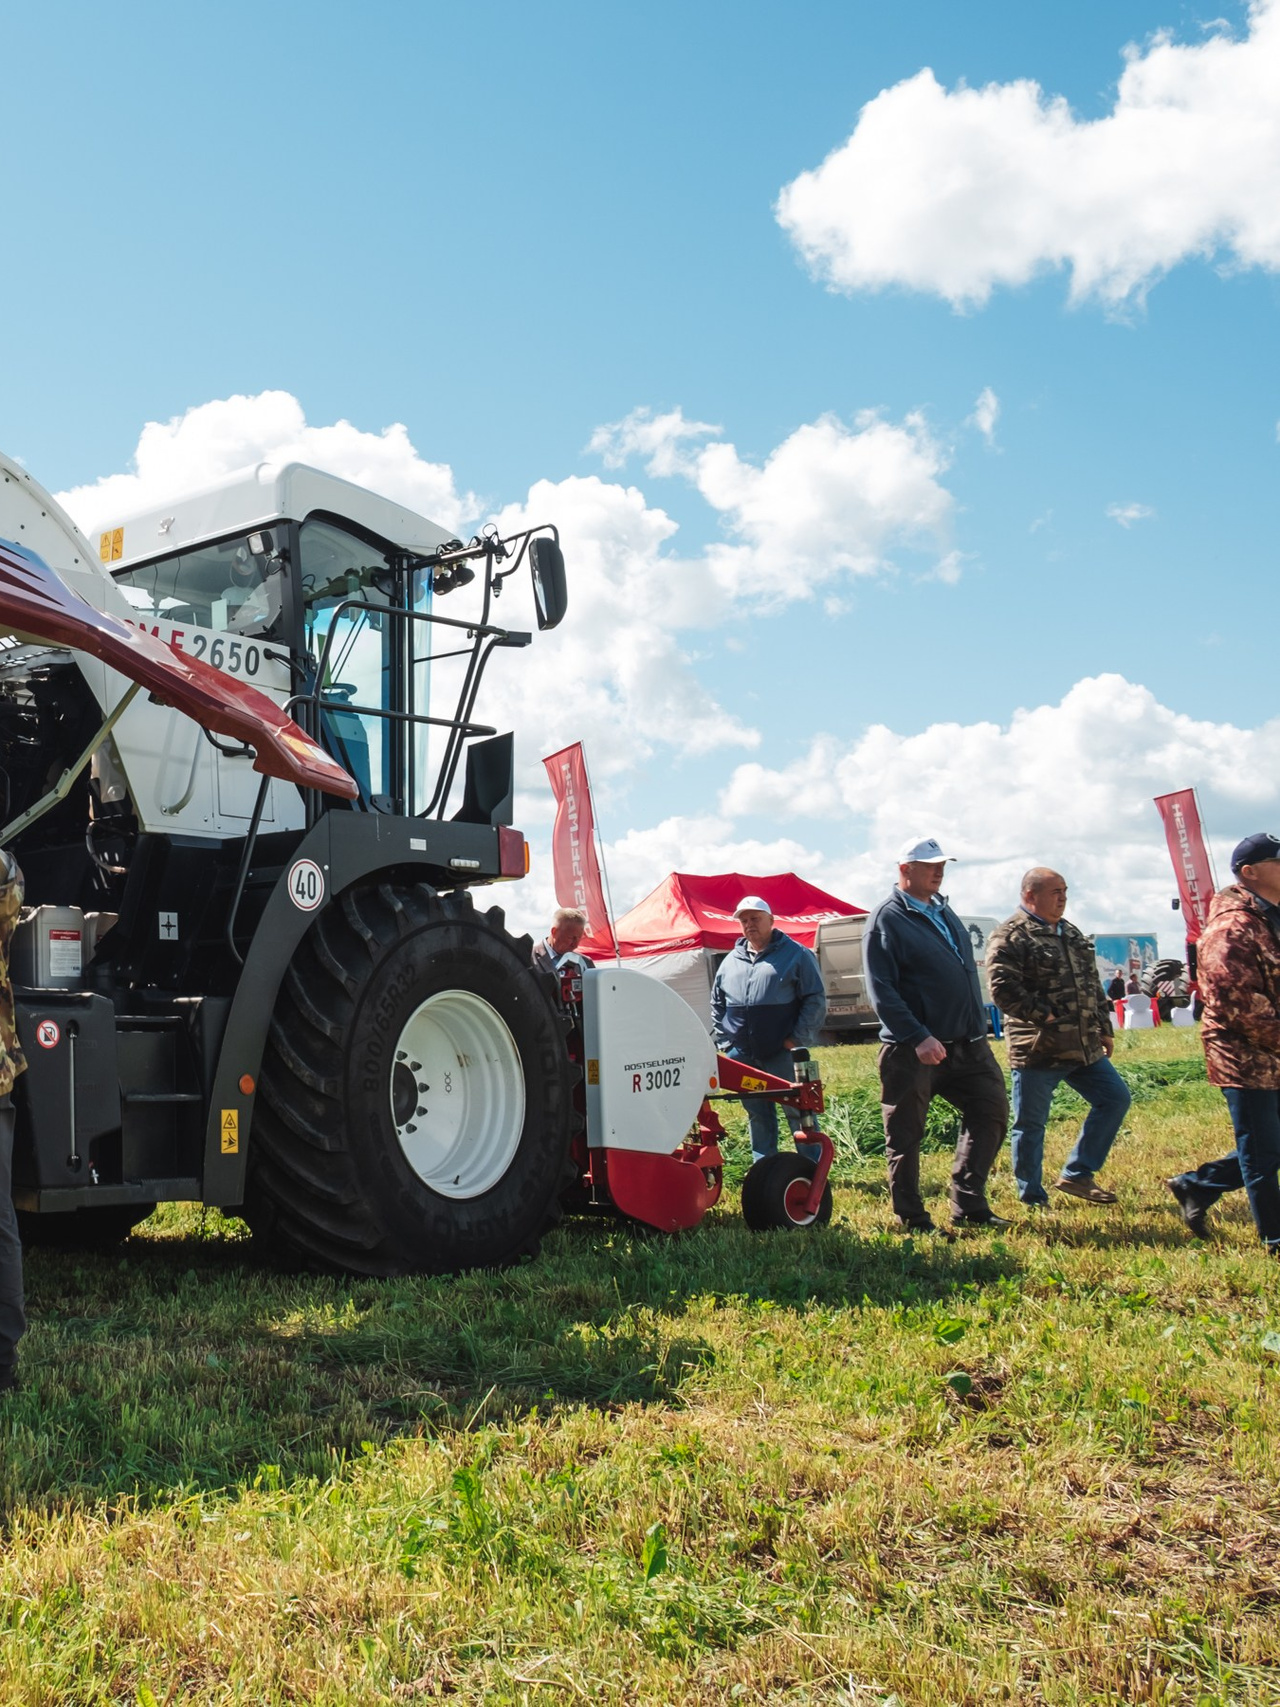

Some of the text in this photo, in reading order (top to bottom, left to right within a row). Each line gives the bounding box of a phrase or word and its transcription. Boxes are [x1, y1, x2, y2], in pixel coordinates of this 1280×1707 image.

[193, 634, 260, 676] 2650
[296, 869, 316, 901] 40
[362, 962, 420, 1093] 800/65R32
[624, 1056, 686, 1071] ROSTSELMASH
[632, 1067, 681, 1093] R 3002
